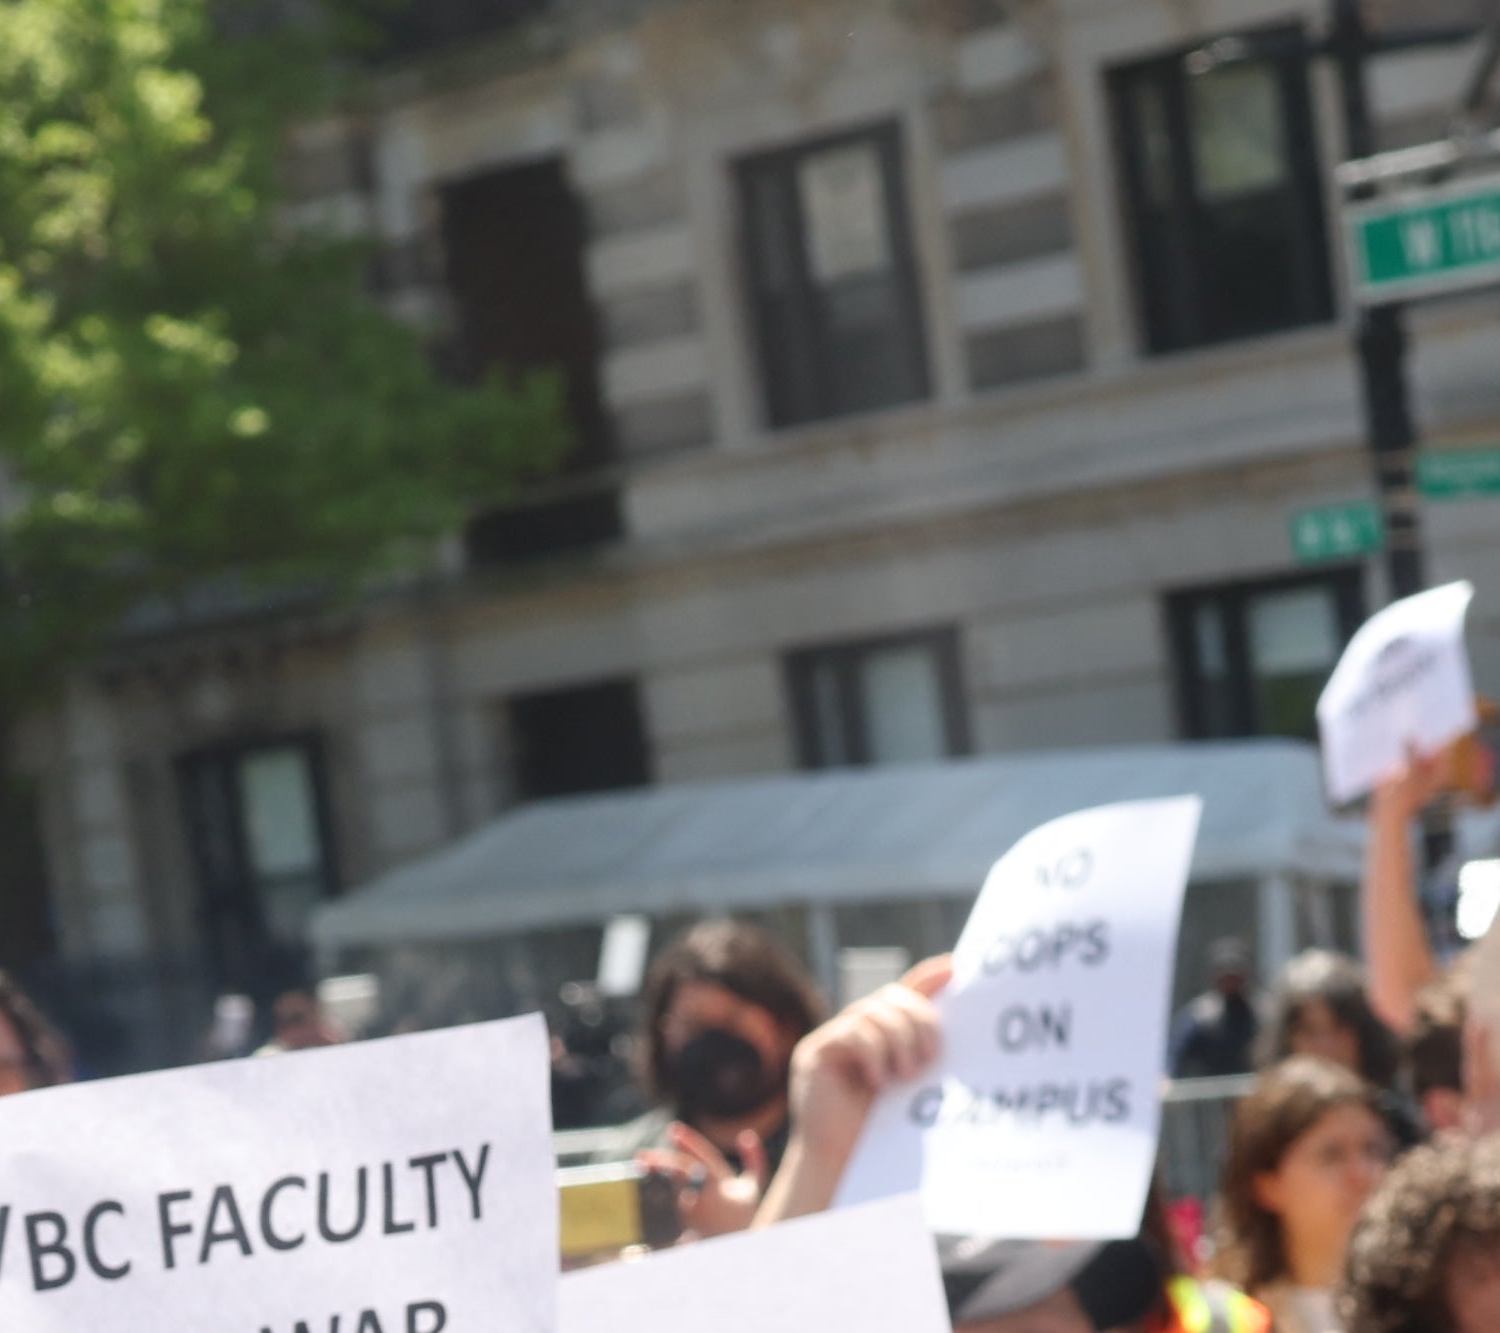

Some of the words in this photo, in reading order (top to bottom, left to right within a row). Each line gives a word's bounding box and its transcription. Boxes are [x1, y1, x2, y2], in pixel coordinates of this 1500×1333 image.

[982, 918, 1110, 974] COPS
[996, 1004, 1074, 1052] ON
[156, 1143, 492, 1271] FACULTY
